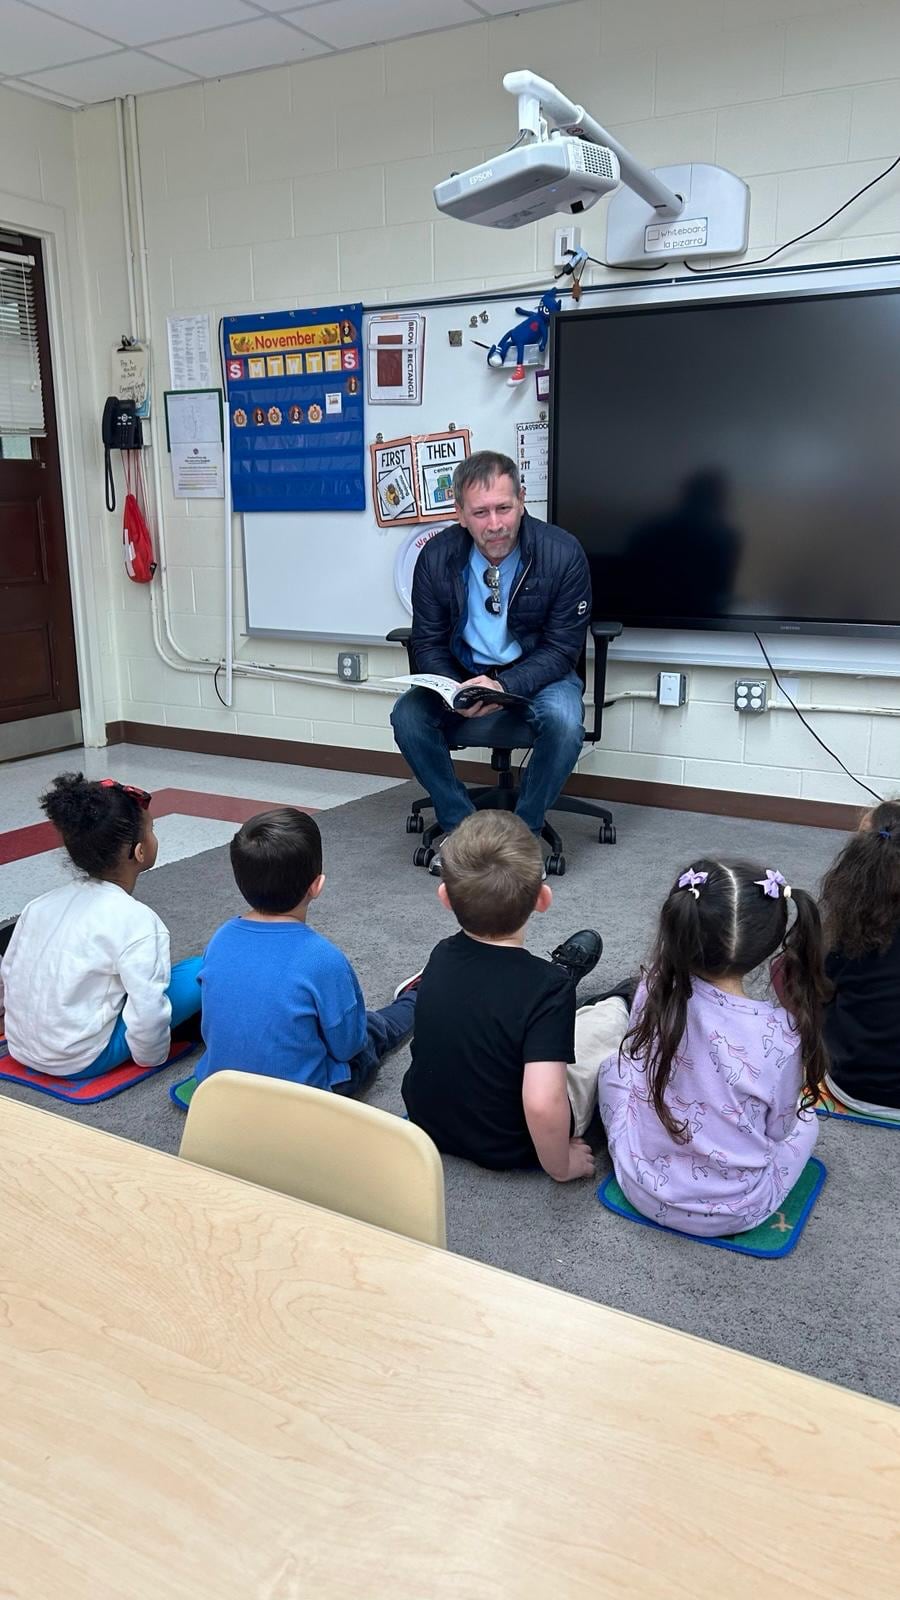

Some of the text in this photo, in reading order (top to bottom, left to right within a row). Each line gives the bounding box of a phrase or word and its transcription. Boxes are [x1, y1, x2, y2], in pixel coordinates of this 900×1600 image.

[469, 169, 493, 185] EPSON
[663, 238, 703, 249] la pizarra
[254, 331, 316, 349] November
[230, 364, 242, 379] S
[344, 353, 356, 369] S
[407, 353, 415, 398] RECTANGLE
[517, 423, 549, 432] CLASSROO
[381, 449, 406, 468] FIRST
[426, 442, 457, 460] THEN
